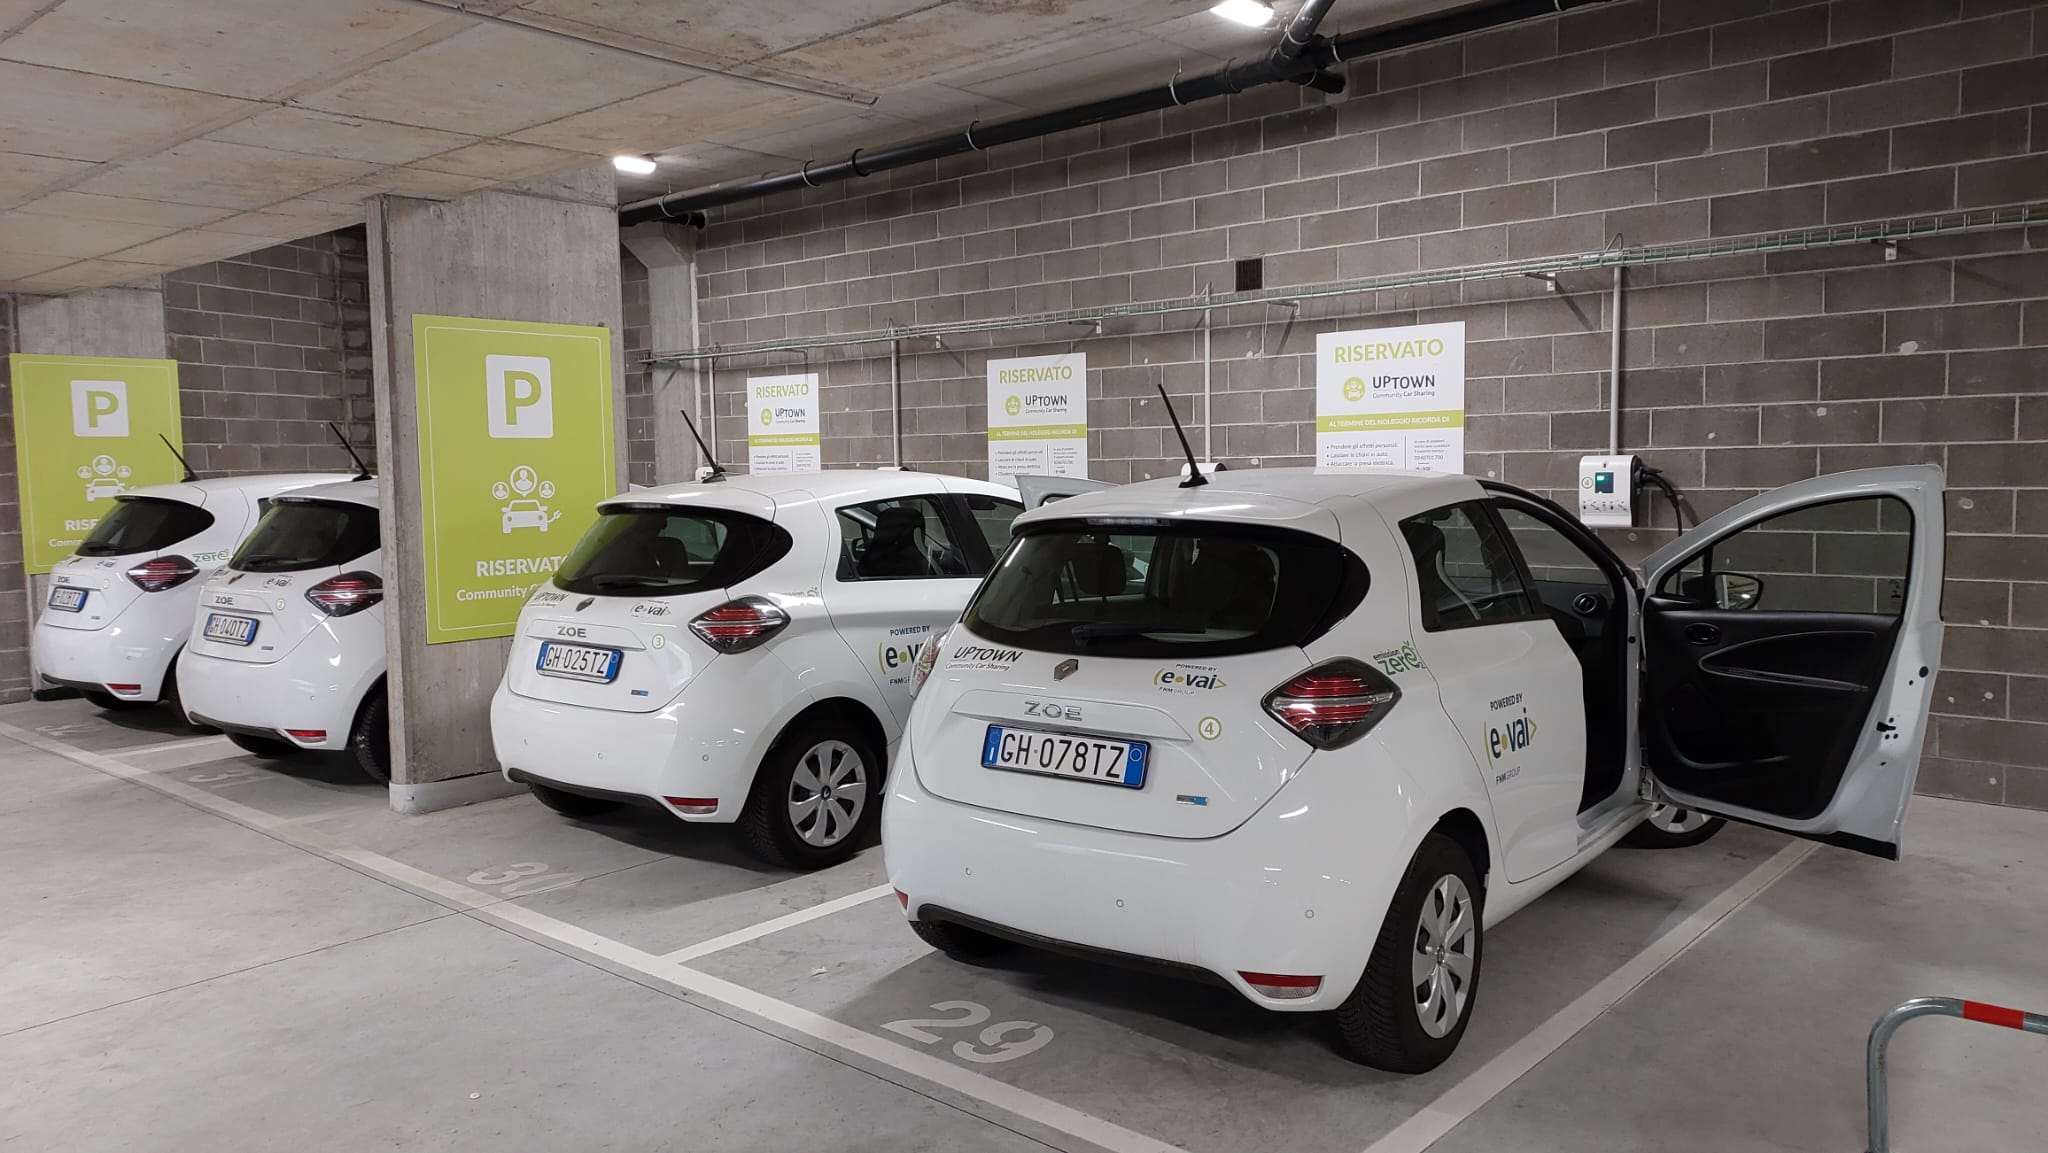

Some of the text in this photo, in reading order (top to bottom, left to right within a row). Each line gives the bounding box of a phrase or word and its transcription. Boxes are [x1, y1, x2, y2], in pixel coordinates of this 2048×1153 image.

[1334, 338, 1444, 364] RISERVATO
[999, 365, 1073, 384] RISERVATO
[1372, 375, 1435, 390] UPTOWN
[503, 370, 542, 425] P
[755, 383, 809, 399] RISERVATO
[1414, 389, 1435, 397] Sharing
[1025, 394, 1067, 407] UPTOWN
[87, 391, 119, 427] P
[774, 407, 805, 418] UPTOWN
[215, 595, 234, 606] ZOE
[456, 583, 528, 602] Community
[557, 626, 587, 638] ZOE
[890, 626, 921, 637] POWERED
[953, 646, 1024, 662] UPTOWN
[986, 662, 1010, 672] Sharing
[1490, 692, 1523, 711] POWERED BY
[1024, 700, 1083, 722] ZOE
[1204, 723, 1214, 735] 4
[466, 862, 585, 898] 30
[879, 1000, 1055, 1064] 29
